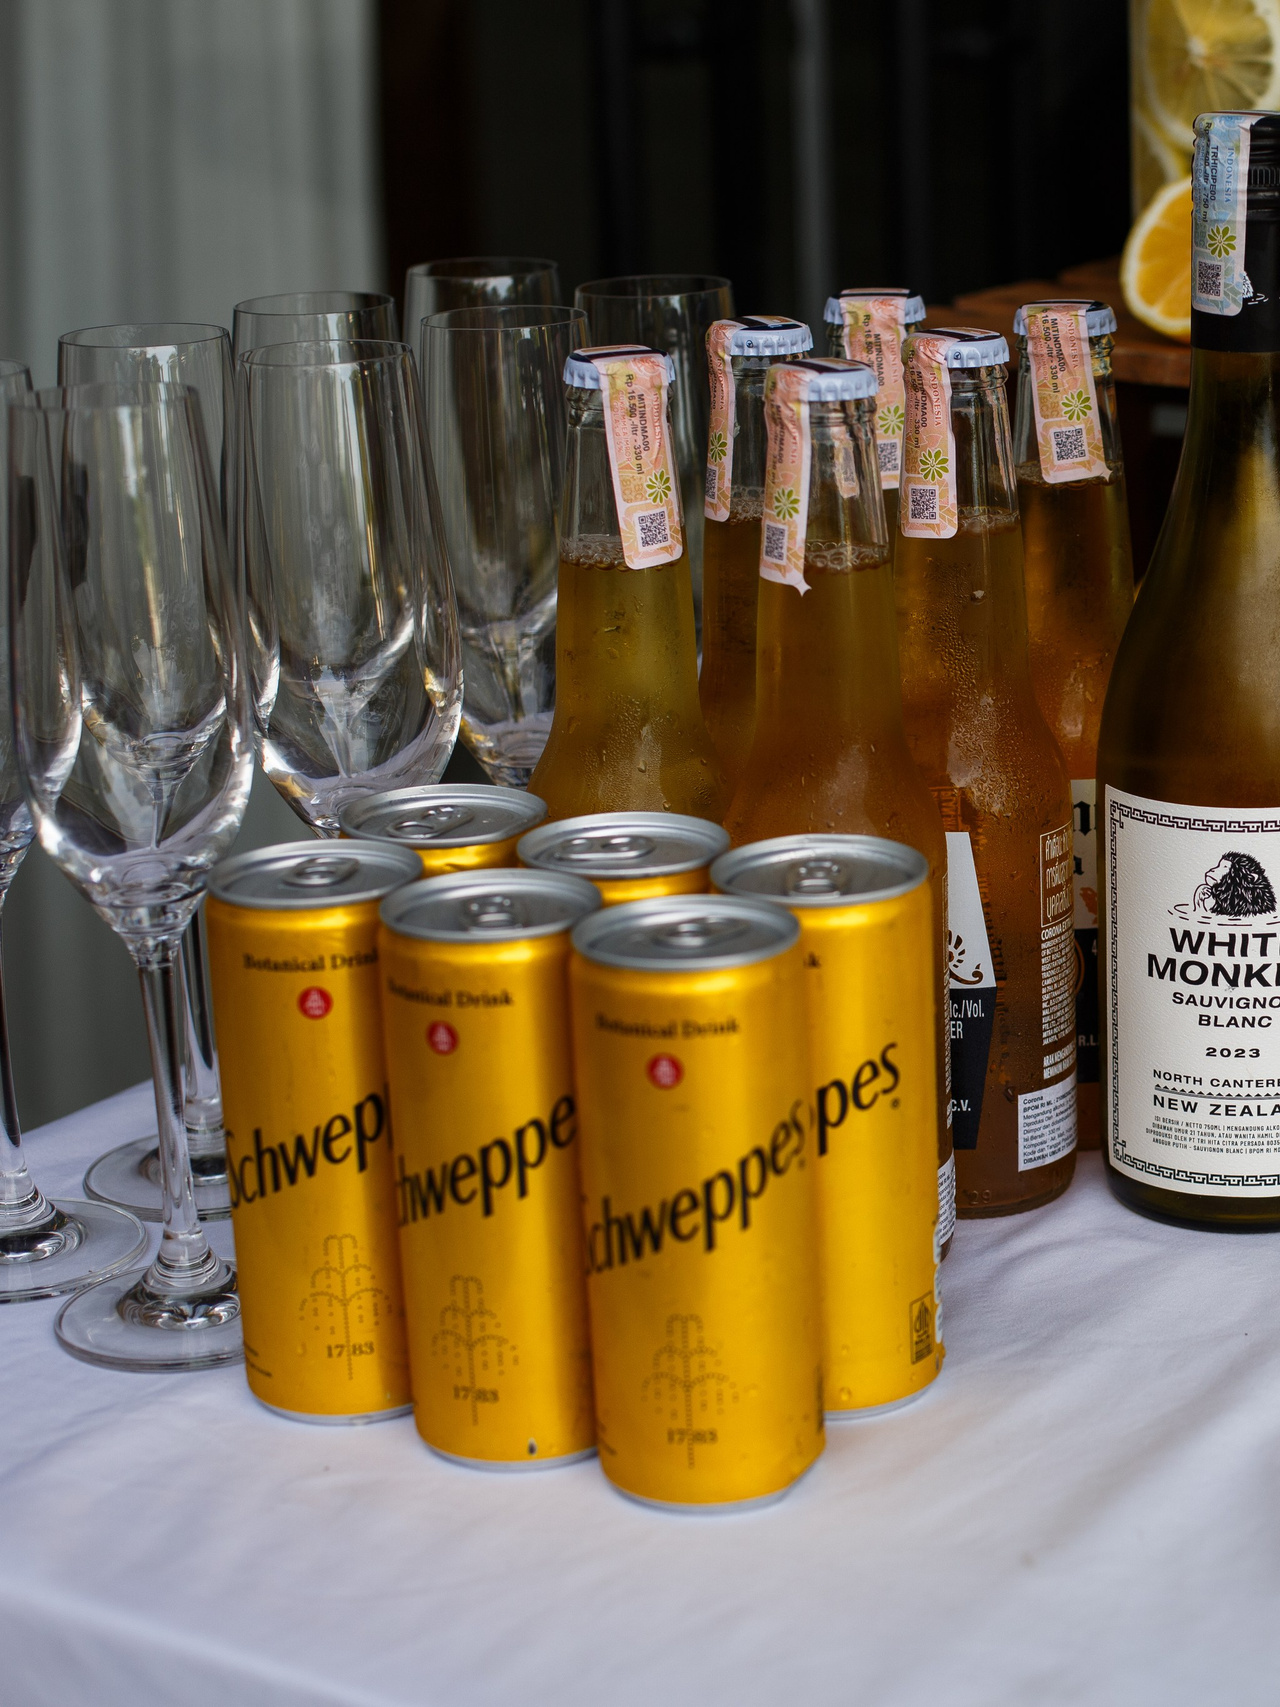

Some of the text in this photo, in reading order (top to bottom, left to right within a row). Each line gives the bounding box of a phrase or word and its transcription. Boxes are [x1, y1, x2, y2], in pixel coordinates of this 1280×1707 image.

[1209, 145, 1219, 201] TRHICIPE00
[1224, 148, 1234, 202] INDONESIA
[862, 314, 871, 328] Rp
[1051, 318, 1065, 371] MITINDMA00
[1067, 318, 1077, 369] INDONESIA
[874, 333, 885, 387] MITINDMA00
[1049, 364, 1059, 379] 330
[625, 374, 633, 388] Rp
[1051, 382, 1061, 393] ml
[916, 370, 928, 428] MITINDMA00
[930, 371, 941, 427] INDONESIA
[638, 393, 650, 452] MITINDMA00
[653, 393, 662, 447] INDONESIA
[633, 444, 643, 461] 330
[636, 464, 645, 475] ml
[1041, 924, 1062, 940] CORONA
[243, 952, 325, 972] Botanical
[456, 988, 513, 1008] Drink
[950, 999, 985, 1018] lc./Vol.
[1198, 1014, 1272, 1028] BLANC
[1206, 1047, 1261, 1058] 2023
[1153, 1069, 1203, 1085] NORTH
[1023, 1096, 1043, 1105] Corona
[1023, 1104, 1039, 1113] BPOM
[1153, 1095, 1199, 1114] NEW
[1023, 1108, 1052, 1120] Mengandung
[1152, 1121, 1173, 1132] DIBAWAH
[1218, 1131, 1232, 1139] ATAU
[1185, 1120, 1202, 1129] NETTO
[1203, 1123, 1221, 1131] 750ML
[1152, 1136, 1171, 1146] ANGGUR
[1172, 1140, 1187, 1149] PUTIH
[1193, 1144, 1223, 1153] SAUVIGNON
[1174, 1133, 1187, 1142] OLEH
[396, 1095, 577, 1228] hweppe
[1023, 1149, 1036, 1157] Kode
[1023, 1152, 1049, 1165] DIBAWAH
[582, 1098, 806, 1276] chweppes
